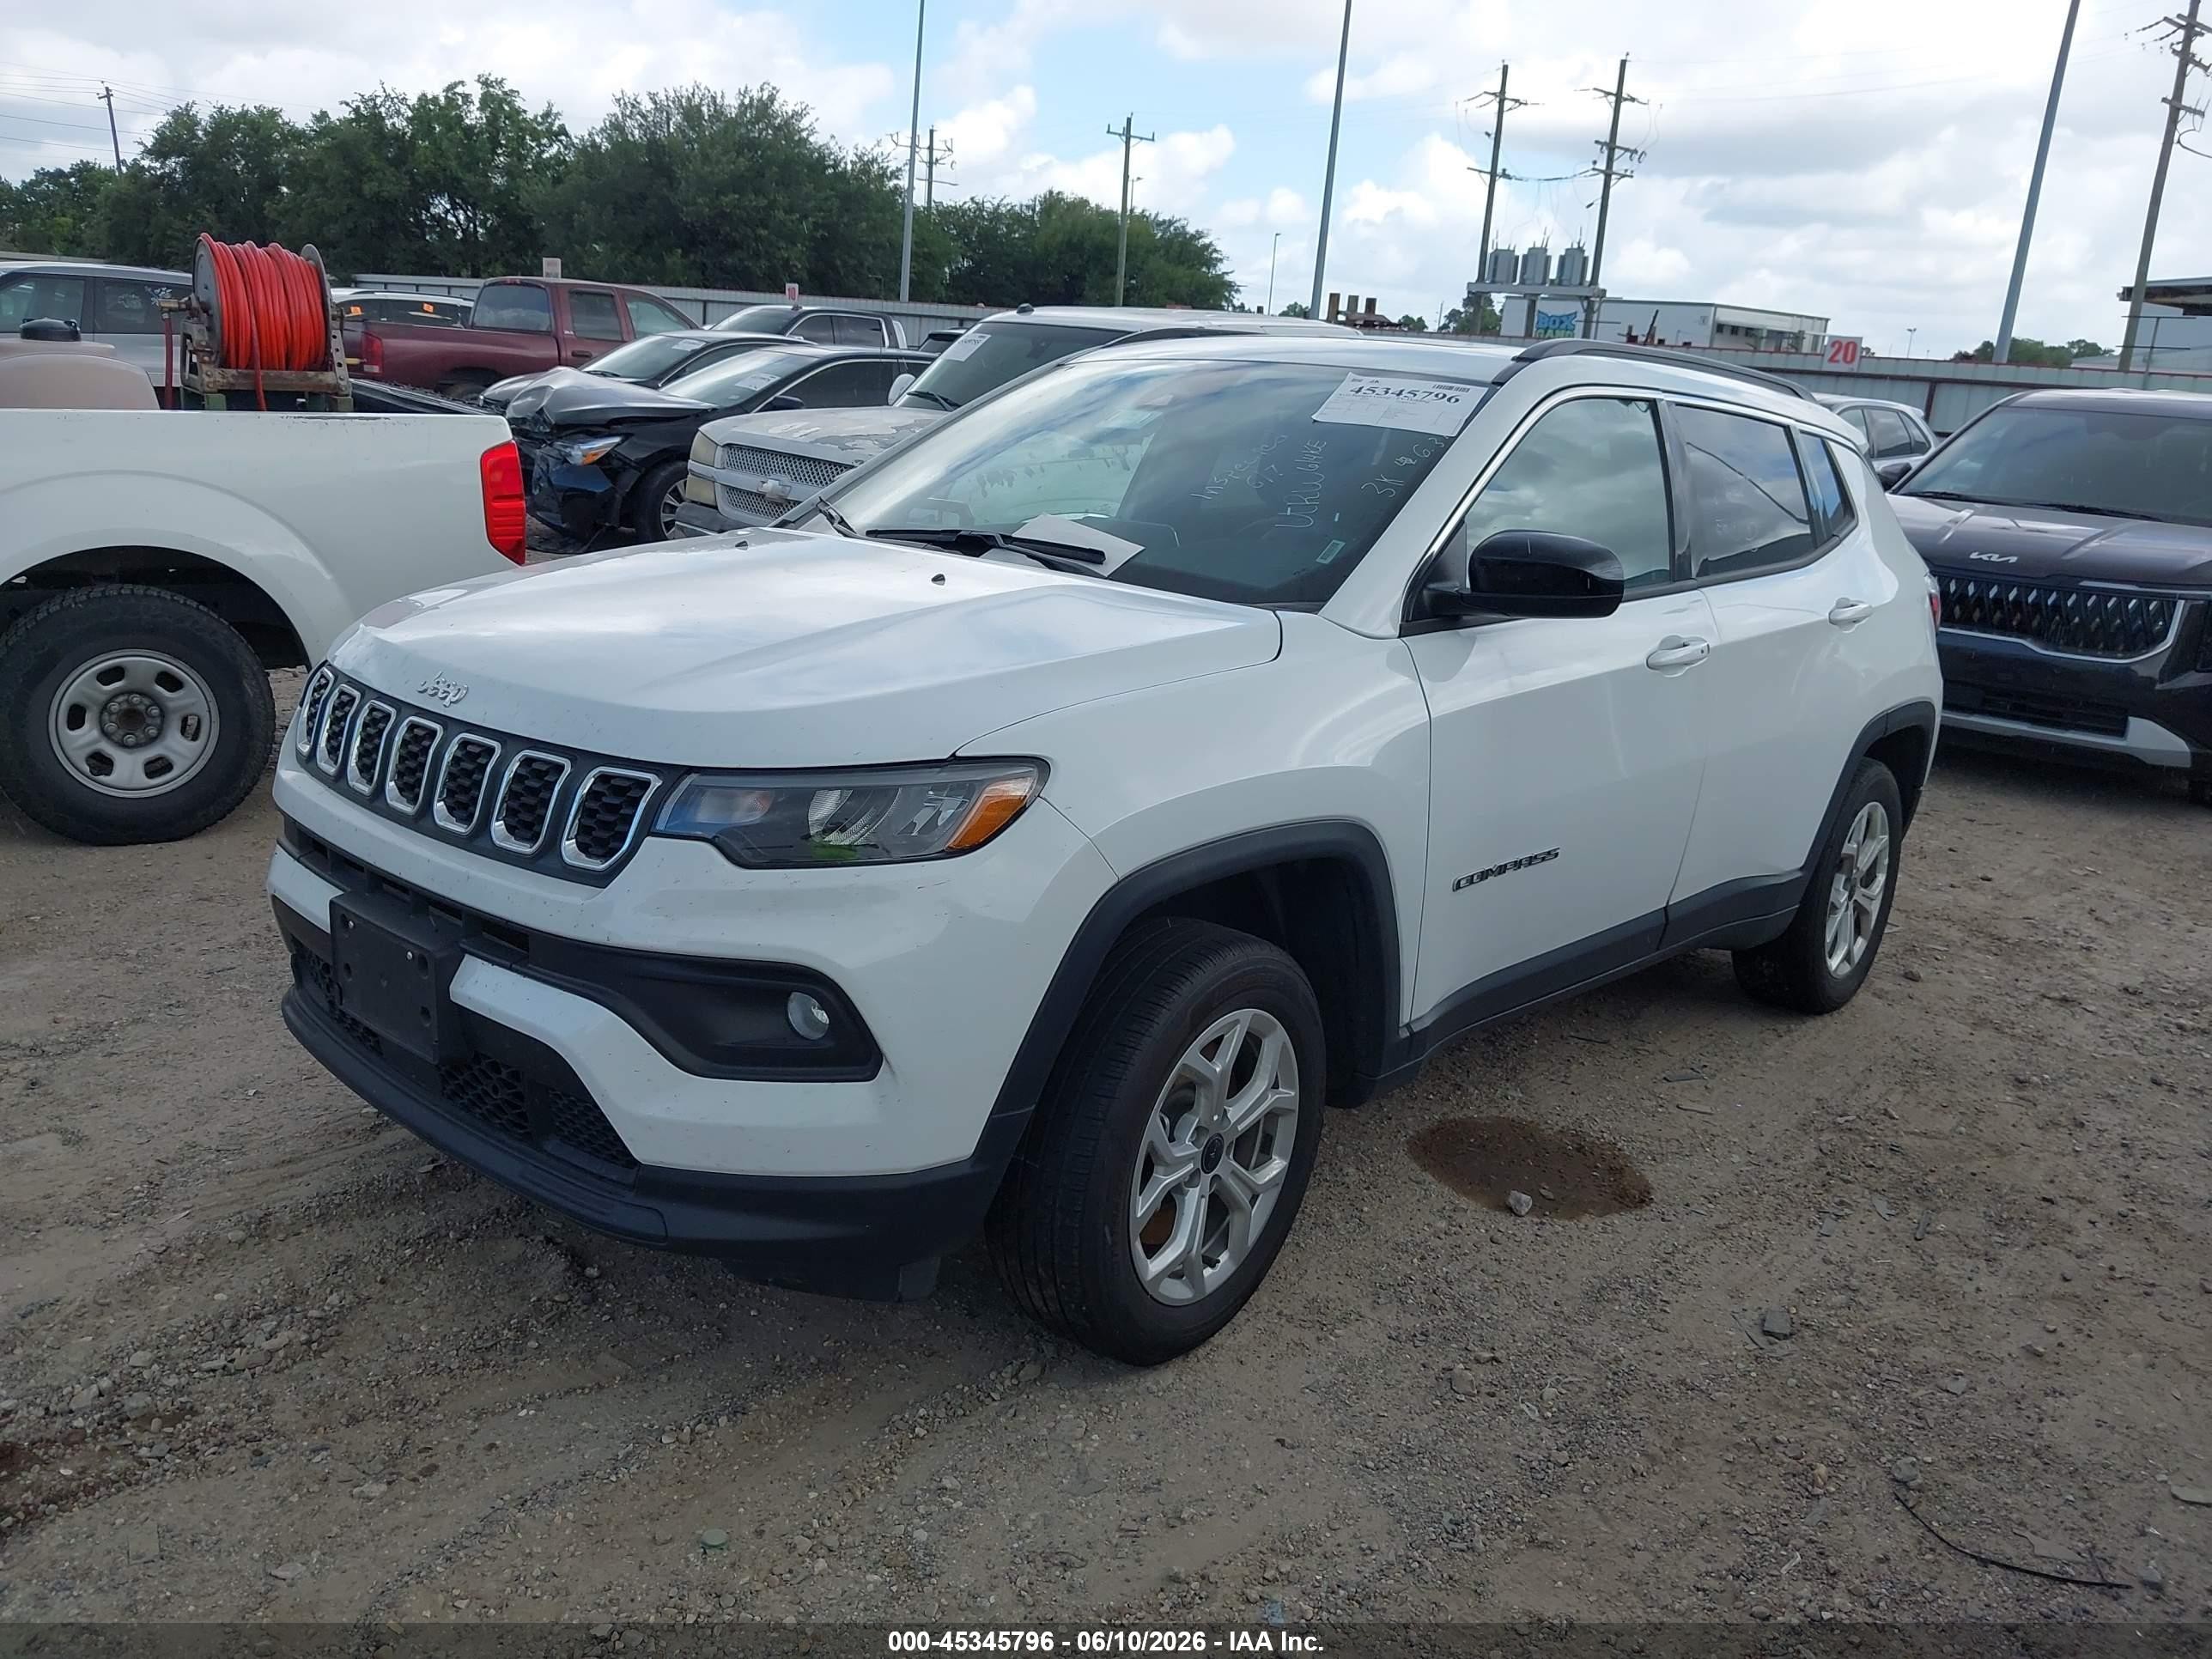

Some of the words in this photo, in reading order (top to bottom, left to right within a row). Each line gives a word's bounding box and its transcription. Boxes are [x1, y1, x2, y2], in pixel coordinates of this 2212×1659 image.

[787, 287, 796, 301] 10
[1537, 311, 1577, 330] BOX
[1827, 339, 1858, 364] 20
[1349, 385, 1462, 404] 45345796
[1969, 551, 2018, 563] KIA
[416, 671, 469, 708] Jeep
[1452, 846, 1560, 892] COMPASS
